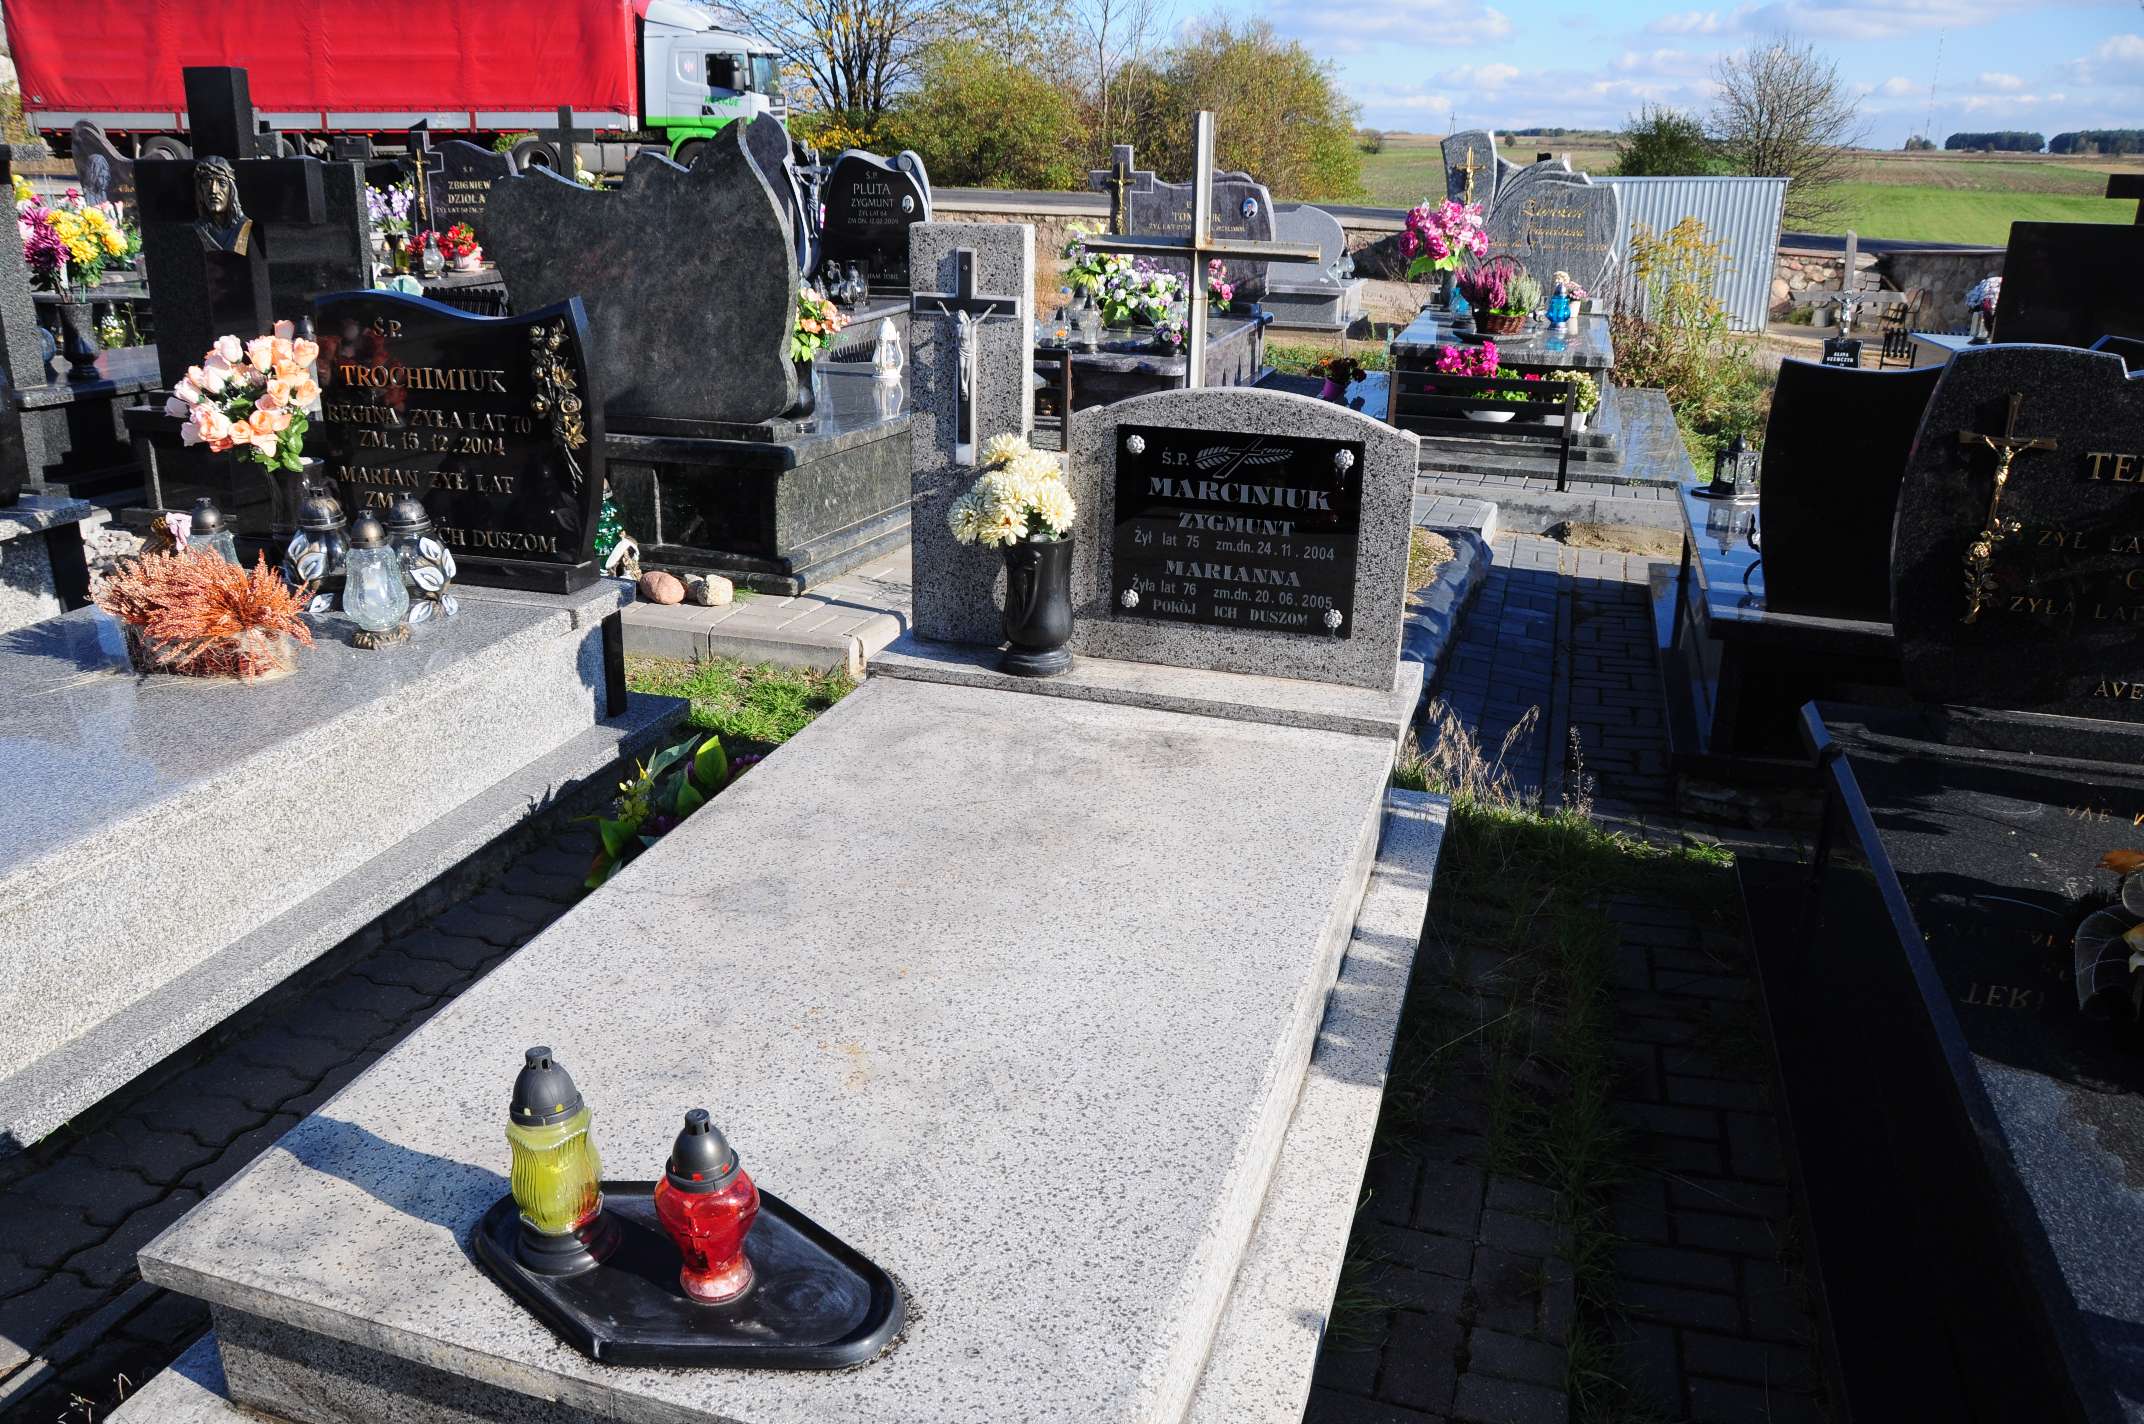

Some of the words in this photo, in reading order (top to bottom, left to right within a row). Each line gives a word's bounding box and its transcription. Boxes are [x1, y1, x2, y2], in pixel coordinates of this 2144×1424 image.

[447, 180, 491, 190] ZBIGNIEW
[853, 183, 891, 195] PLUTA
[851, 198, 894, 208] ZYGMUNT
[339, 364, 507, 393] TROCHIMIUK
[328, 404, 401, 426] REGINA
[465, 411, 507, 432] LAT
[359, 430, 395, 448] ZM.
[337, 465, 419, 488] MARIAN
[474, 474, 515, 496] LAT
[1147, 477, 1331, 511] MARCINIUK
[1178, 511, 1296, 537] ZYGMUNT
[471, 528, 558, 554] DUSZOM
[1134, 526, 1152, 546] Żył
[1162, 531, 1177, 547] lat
[1186, 534, 1200, 549] 75
[1132, 573, 1155, 594] Żyła
[1161, 579, 1176, 595] lat
[1183, 582, 1197, 596] 76
[1164, 559, 1301, 587] MARIANNA
[1152, 598, 1197, 615] POKÓJ
[1214, 607, 1238, 620] ICH
[1250, 609, 1308, 626] DUSZOM
[2094, 680, 2144, 700] AVE
